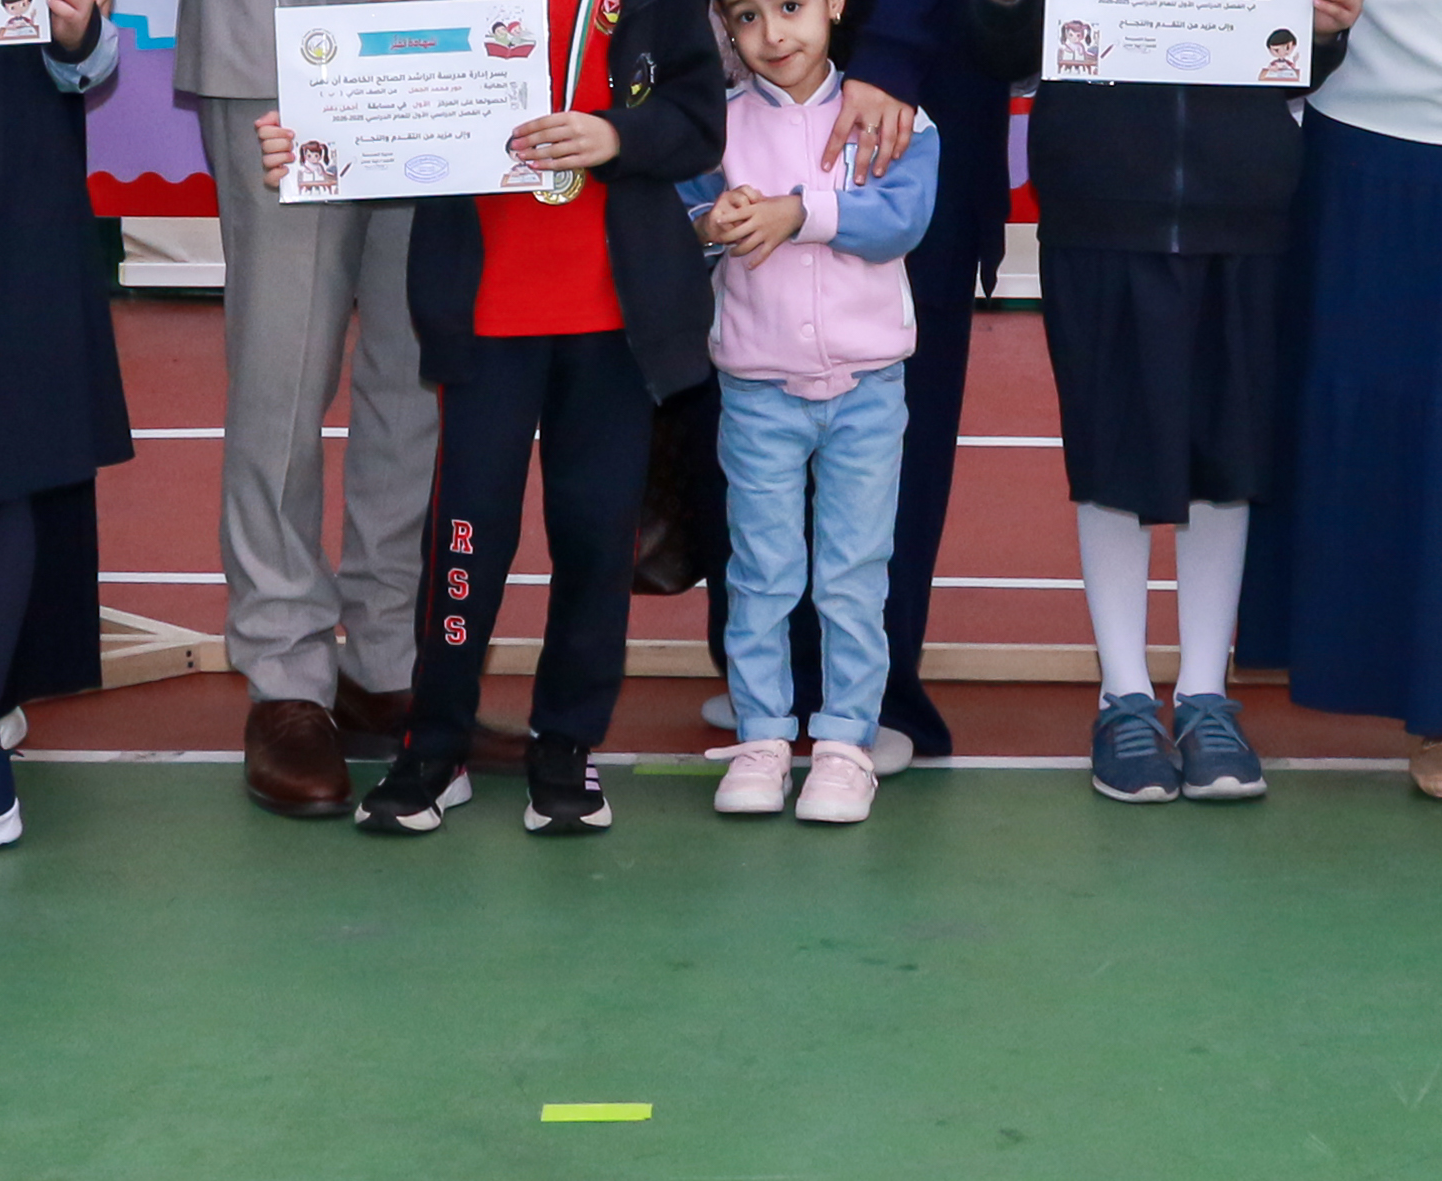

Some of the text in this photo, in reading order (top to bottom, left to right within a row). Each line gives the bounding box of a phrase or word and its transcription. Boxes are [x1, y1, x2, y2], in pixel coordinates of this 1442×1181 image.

[1246, 3, 1256, 12] في
[1186, 22, 1198, 30] من
[375, 73, 405, 85] الصالح
[407, 71, 435, 82] الراشد
[436, 71, 466, 81] مدرسة
[468, 69, 488, 80] إدارة
[488, 70, 507, 79] يسر
[330, 74, 341, 86] أن
[342, 75, 373, 84] الخاصة
[387, 87, 397, 95] من
[396, 101, 407, 111] في
[460, 98, 473, 107] على
[481, 107, 491, 118] في
[422, 132, 434, 141] من
